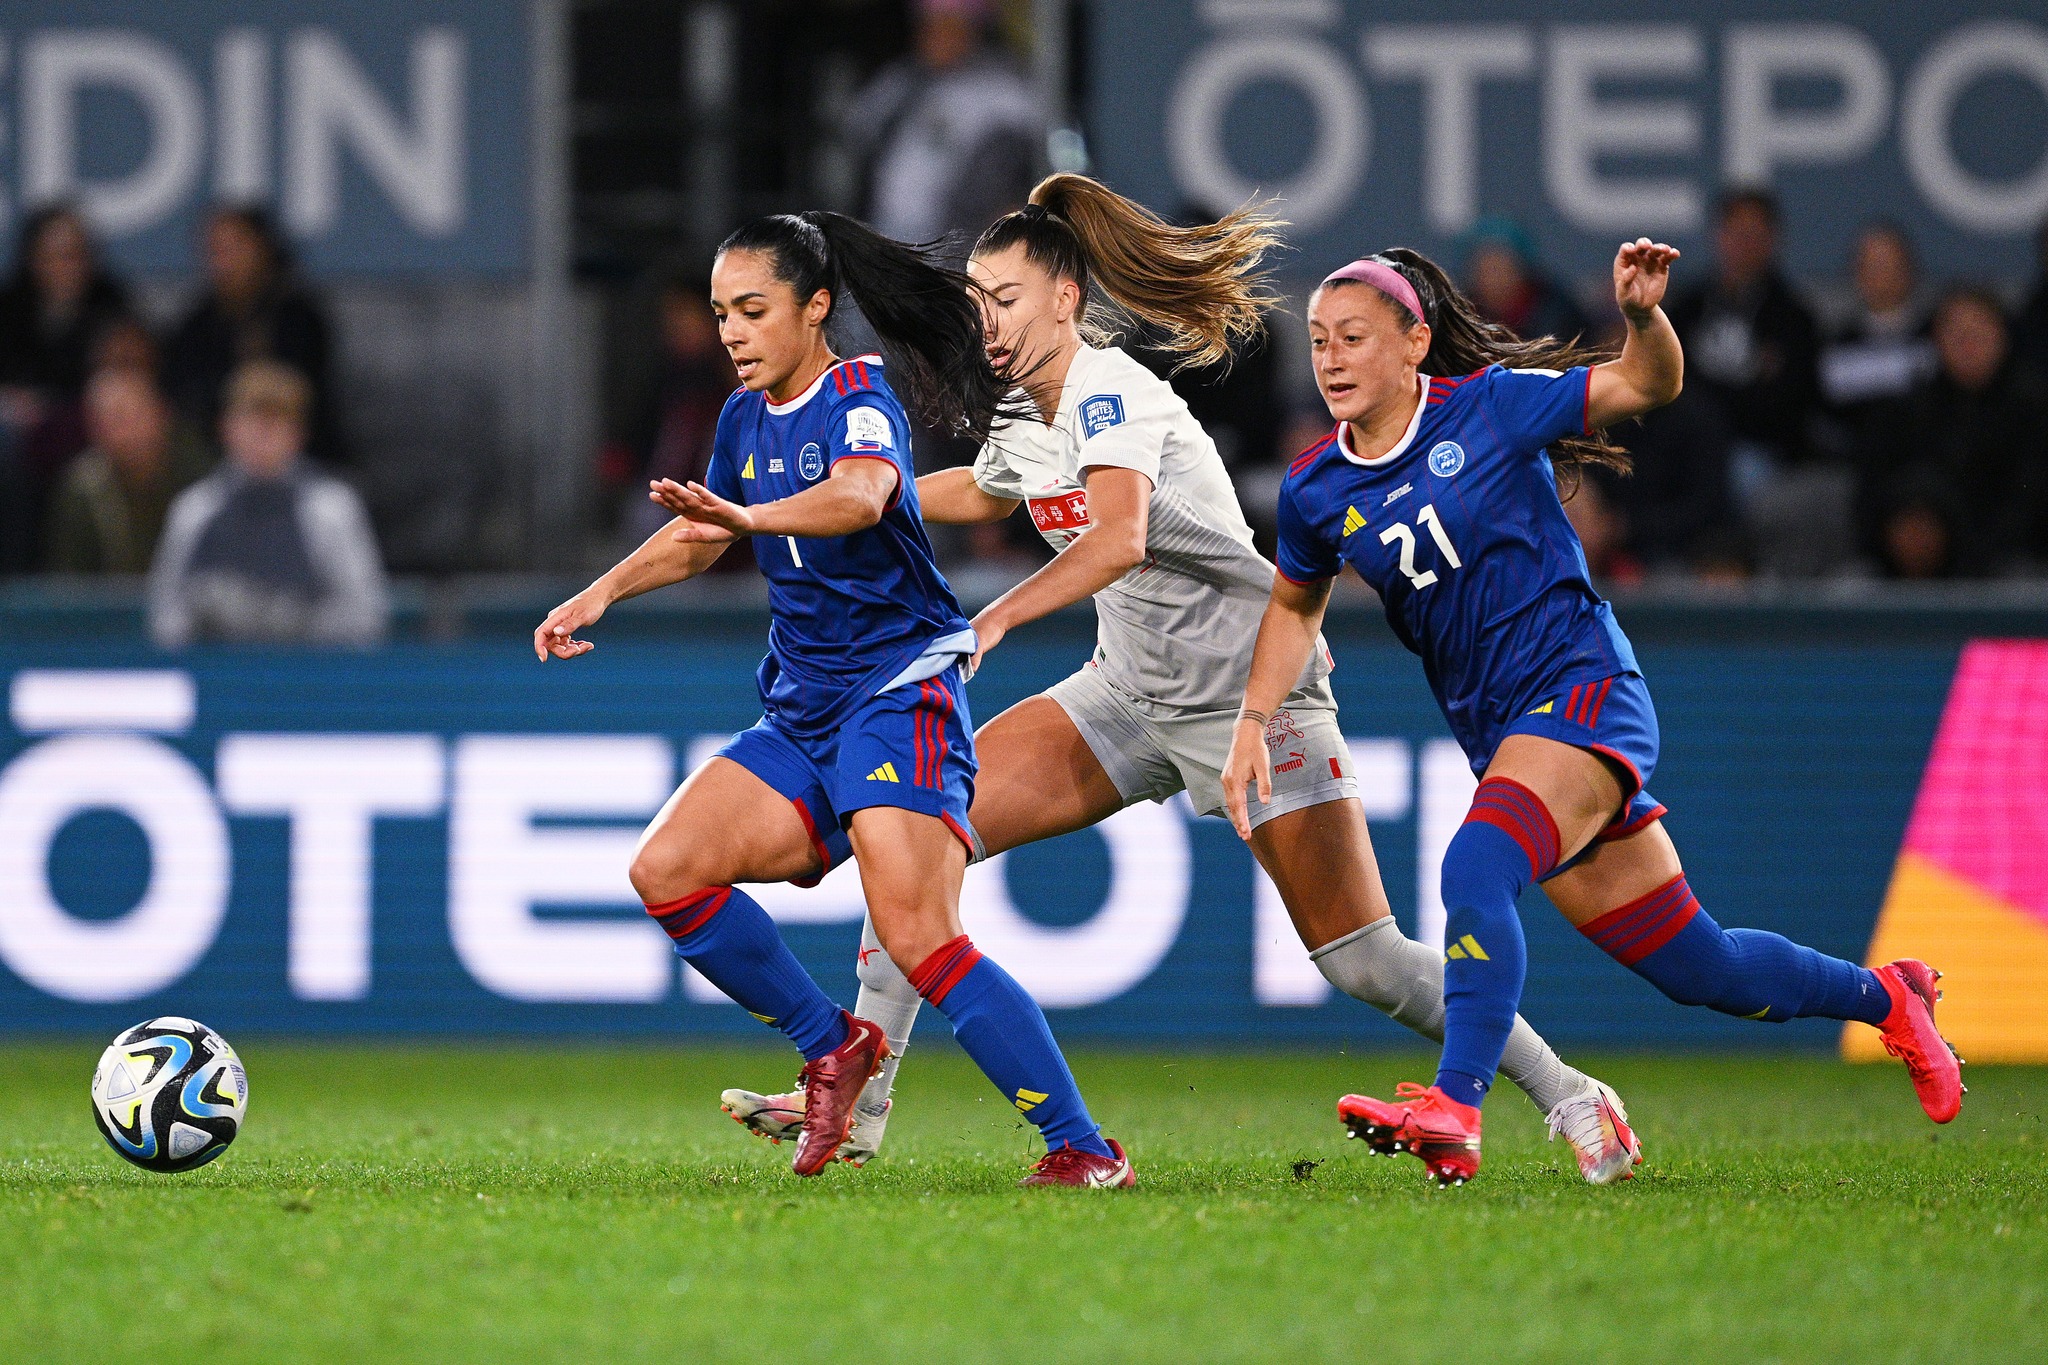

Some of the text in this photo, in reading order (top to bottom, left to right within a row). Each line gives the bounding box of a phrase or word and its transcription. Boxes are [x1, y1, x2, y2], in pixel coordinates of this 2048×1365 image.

[0, 31, 466, 235] DIN
[1087, 406, 1114, 419] UNITES
[805, 463, 818, 471] PFF
[1378, 503, 1462, 590] 21
[1274, 758, 1304, 775] PUMA
